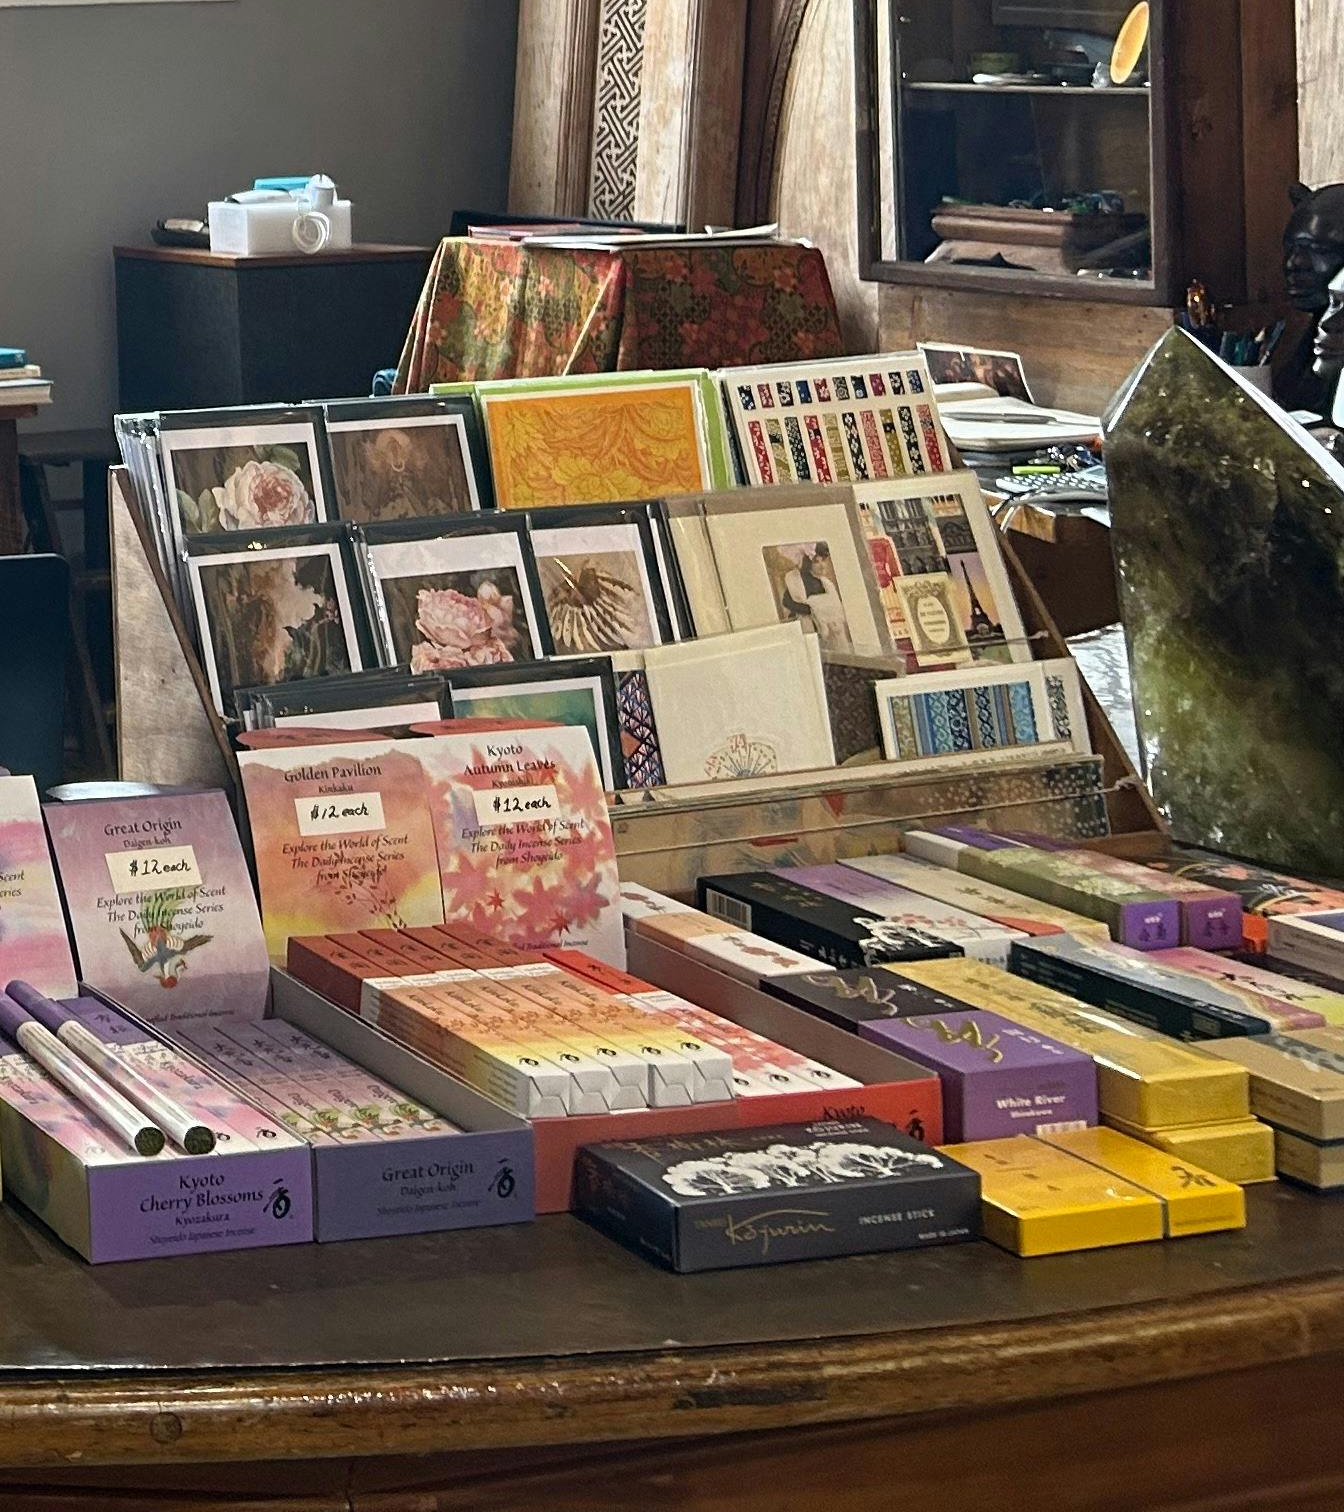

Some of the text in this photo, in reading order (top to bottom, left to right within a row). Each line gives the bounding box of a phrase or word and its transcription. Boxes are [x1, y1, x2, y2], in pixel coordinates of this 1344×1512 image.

[487, 744, 523, 759] Kyoto
[284, 763, 383, 782] Golden Pavilion
[463, 758, 557, 777] Autumn Leaves
[310, 802, 369, 821] $12 each
[492, 795, 552, 813] $12 each
[104, 817, 183, 838] Great Origin
[461, 825, 497, 842] Explore
[497, 822, 514, 835] the
[515, 819, 547, 834] World
[559, 819, 585, 831] Scent
[282, 833, 409, 856] Explore the World of Scent
[471, 836, 583, 855] The Daily Incense Series
[162, 858, 192, 873] each
[291, 857, 309, 869] The
[377, 851, 405, 862] Series
[495, 855, 520, 869] from
[96, 885, 227, 914] Explore the World of Scent
[107, 911, 126, 923] The
[195, 902, 225, 915] Series
[996, 1095, 1066, 1110] White River
[381, 1161, 475, 1183] Great Origin
[179, 1173, 225, 1195] Kyoto
[139, 1188, 264, 1214] Cherry Blossoms
[174, 1212, 231, 1227] Kyozakura
[858, 1212, 903, 1225] INCENSE
